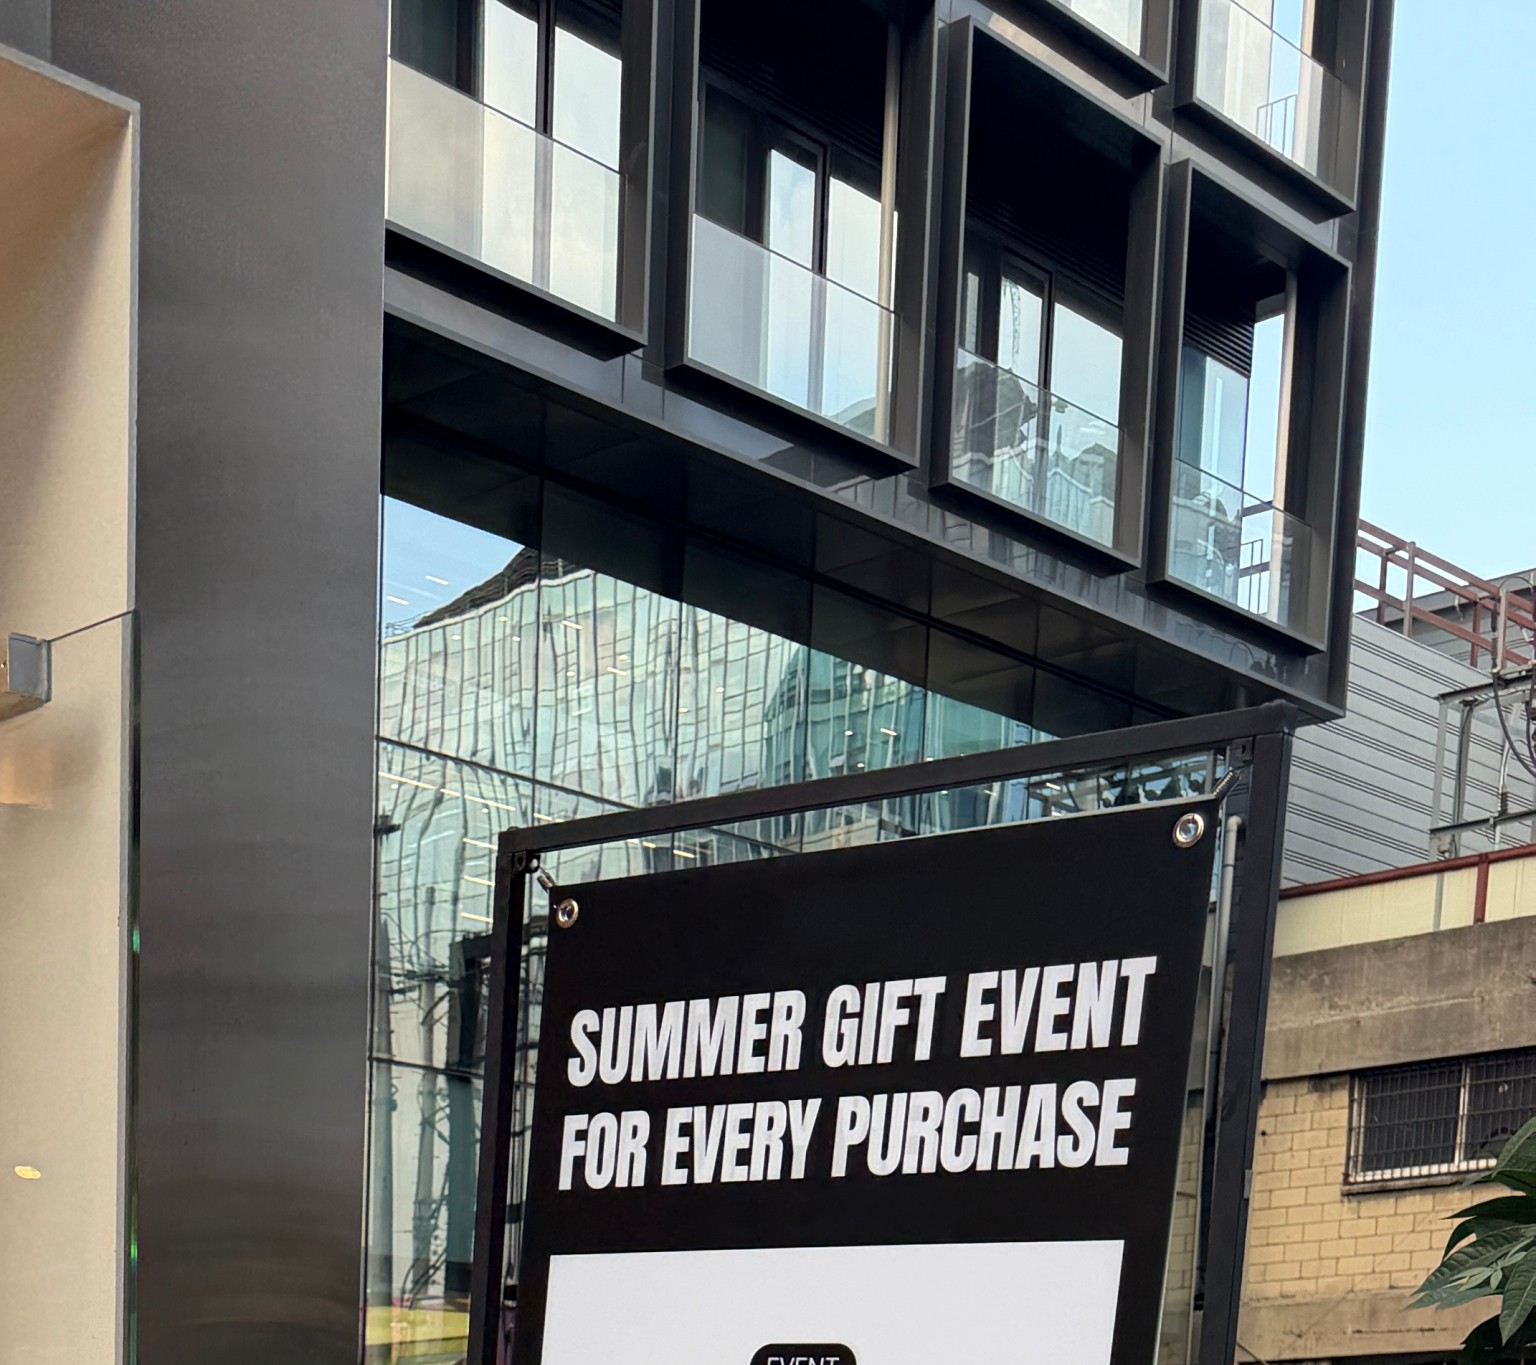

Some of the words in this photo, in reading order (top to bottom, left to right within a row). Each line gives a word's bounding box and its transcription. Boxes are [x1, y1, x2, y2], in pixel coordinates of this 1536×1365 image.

[568, 990, 806, 1086] SUMMER
[823, 976, 946, 1067] GIFT
[960, 956, 1157, 1057] EVENT
[559, 1111, 650, 1190] FOR
[661, 1098, 822, 1185] EVERY
[831, 1078, 1136, 1177] PURCHASE
